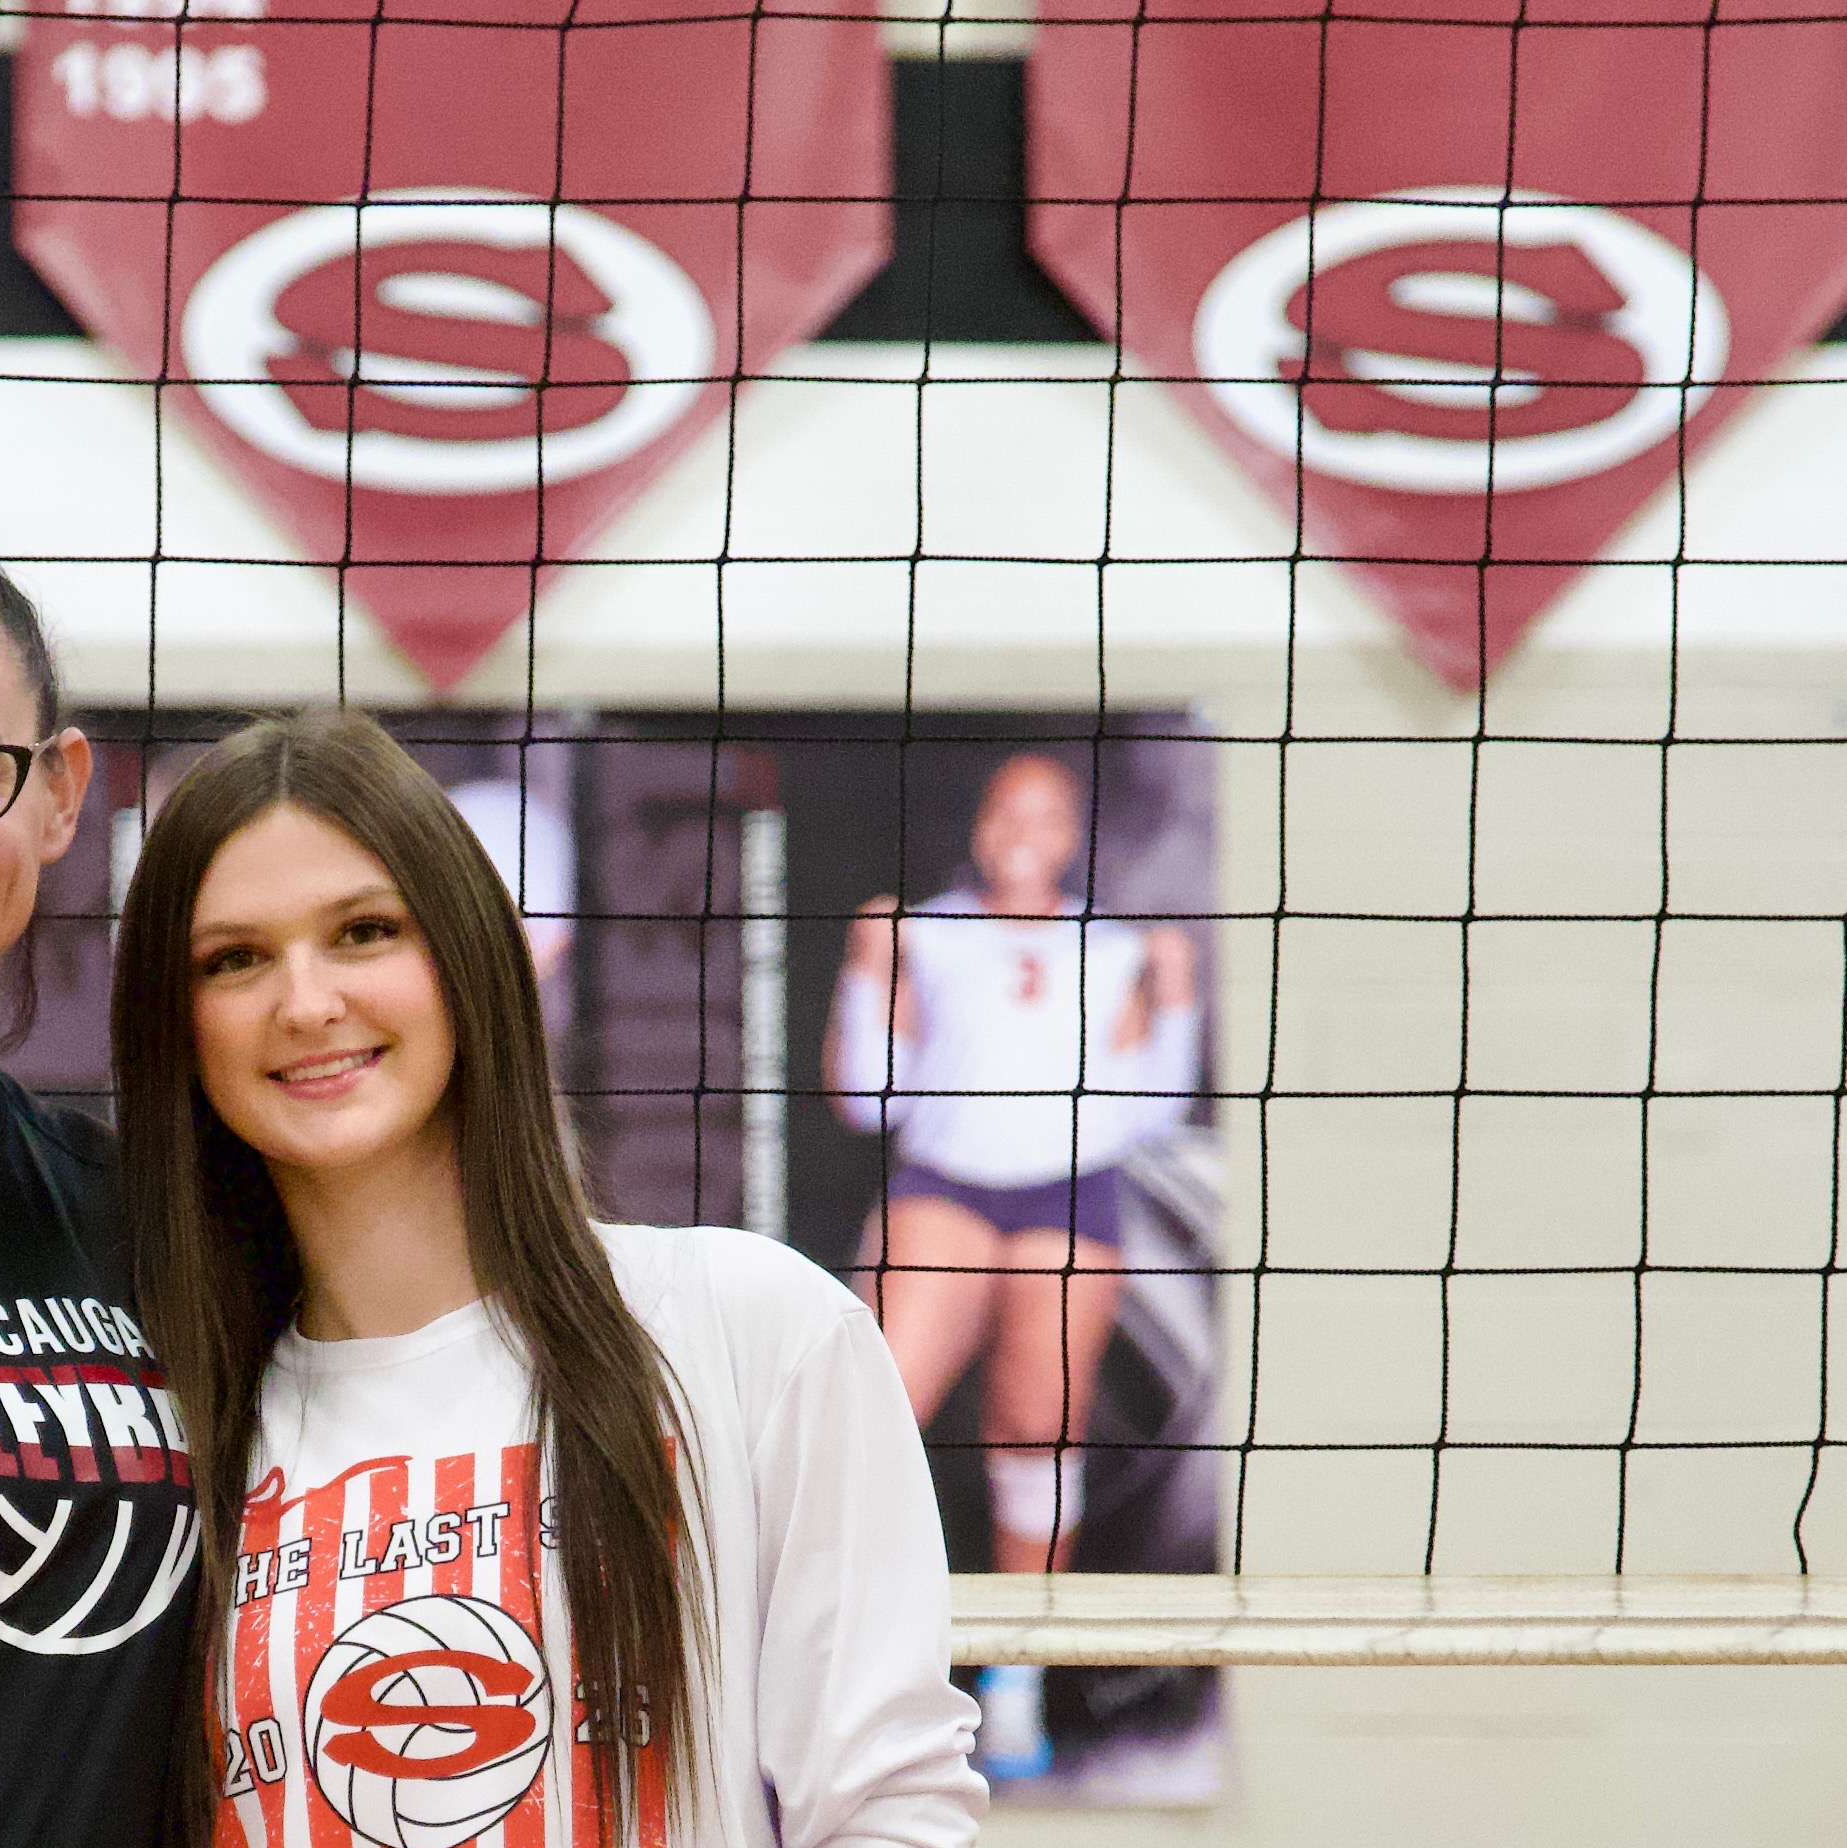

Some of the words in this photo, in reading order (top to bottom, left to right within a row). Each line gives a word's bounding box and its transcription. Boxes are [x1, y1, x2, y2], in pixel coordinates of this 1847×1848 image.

[234, 1537, 312, 1608] HE
[339, 1502, 510, 1581] LAST
[224, 1717, 287, 1798] 20
